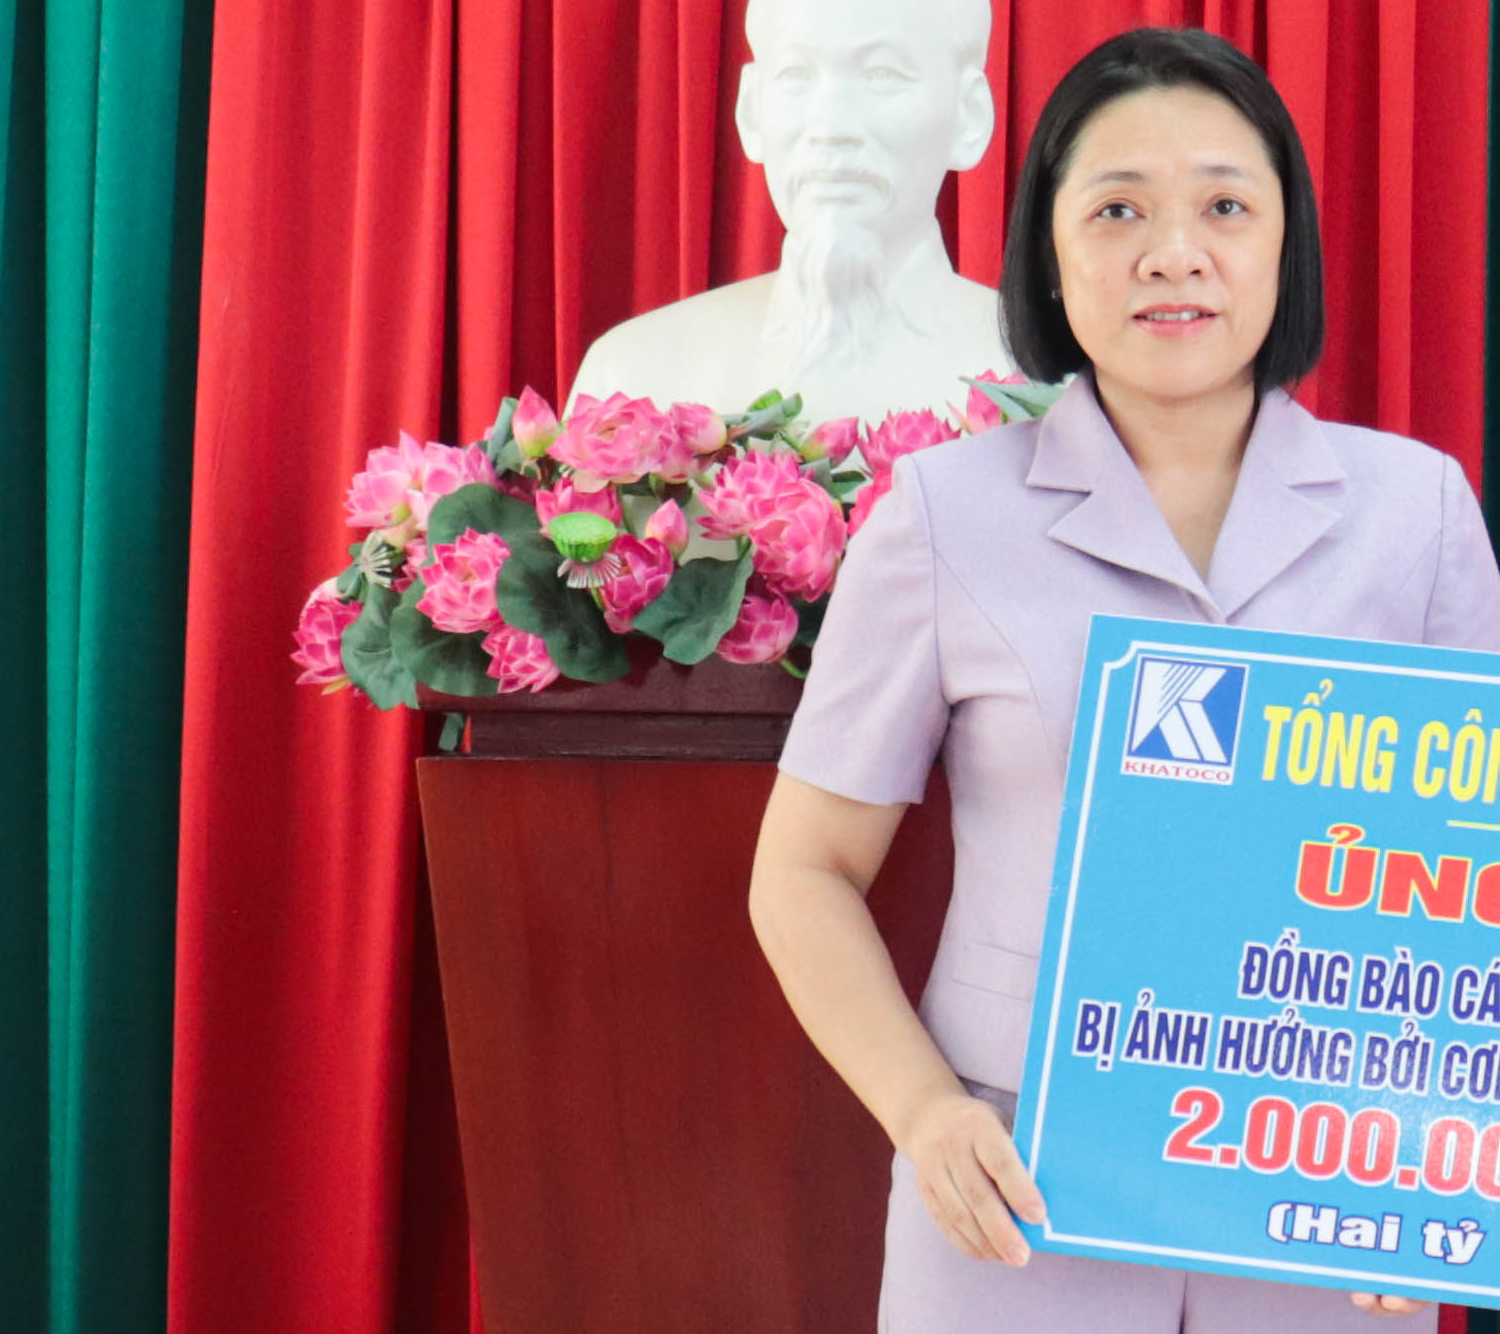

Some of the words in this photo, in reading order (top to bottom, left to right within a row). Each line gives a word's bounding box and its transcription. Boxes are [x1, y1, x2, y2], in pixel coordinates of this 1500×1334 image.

[1125, 761, 1229, 782] KHATOCO
[1261, 678, 1400, 793] TỔNG
[1239, 929, 1350, 1008] ĐỒNG
[1360, 946, 1441, 1018] BÀO
[1073, 999, 1121, 1071] BỊ
[1121, 988, 1213, 1070] ẢNH
[1214, 1006, 1354, 1088] HƯỞNG
[1359, 1019, 1435, 1096] BỞI
[1266, 1200, 1400, 1255] (Hai
[1420, 1210, 1484, 1270] tỷ
